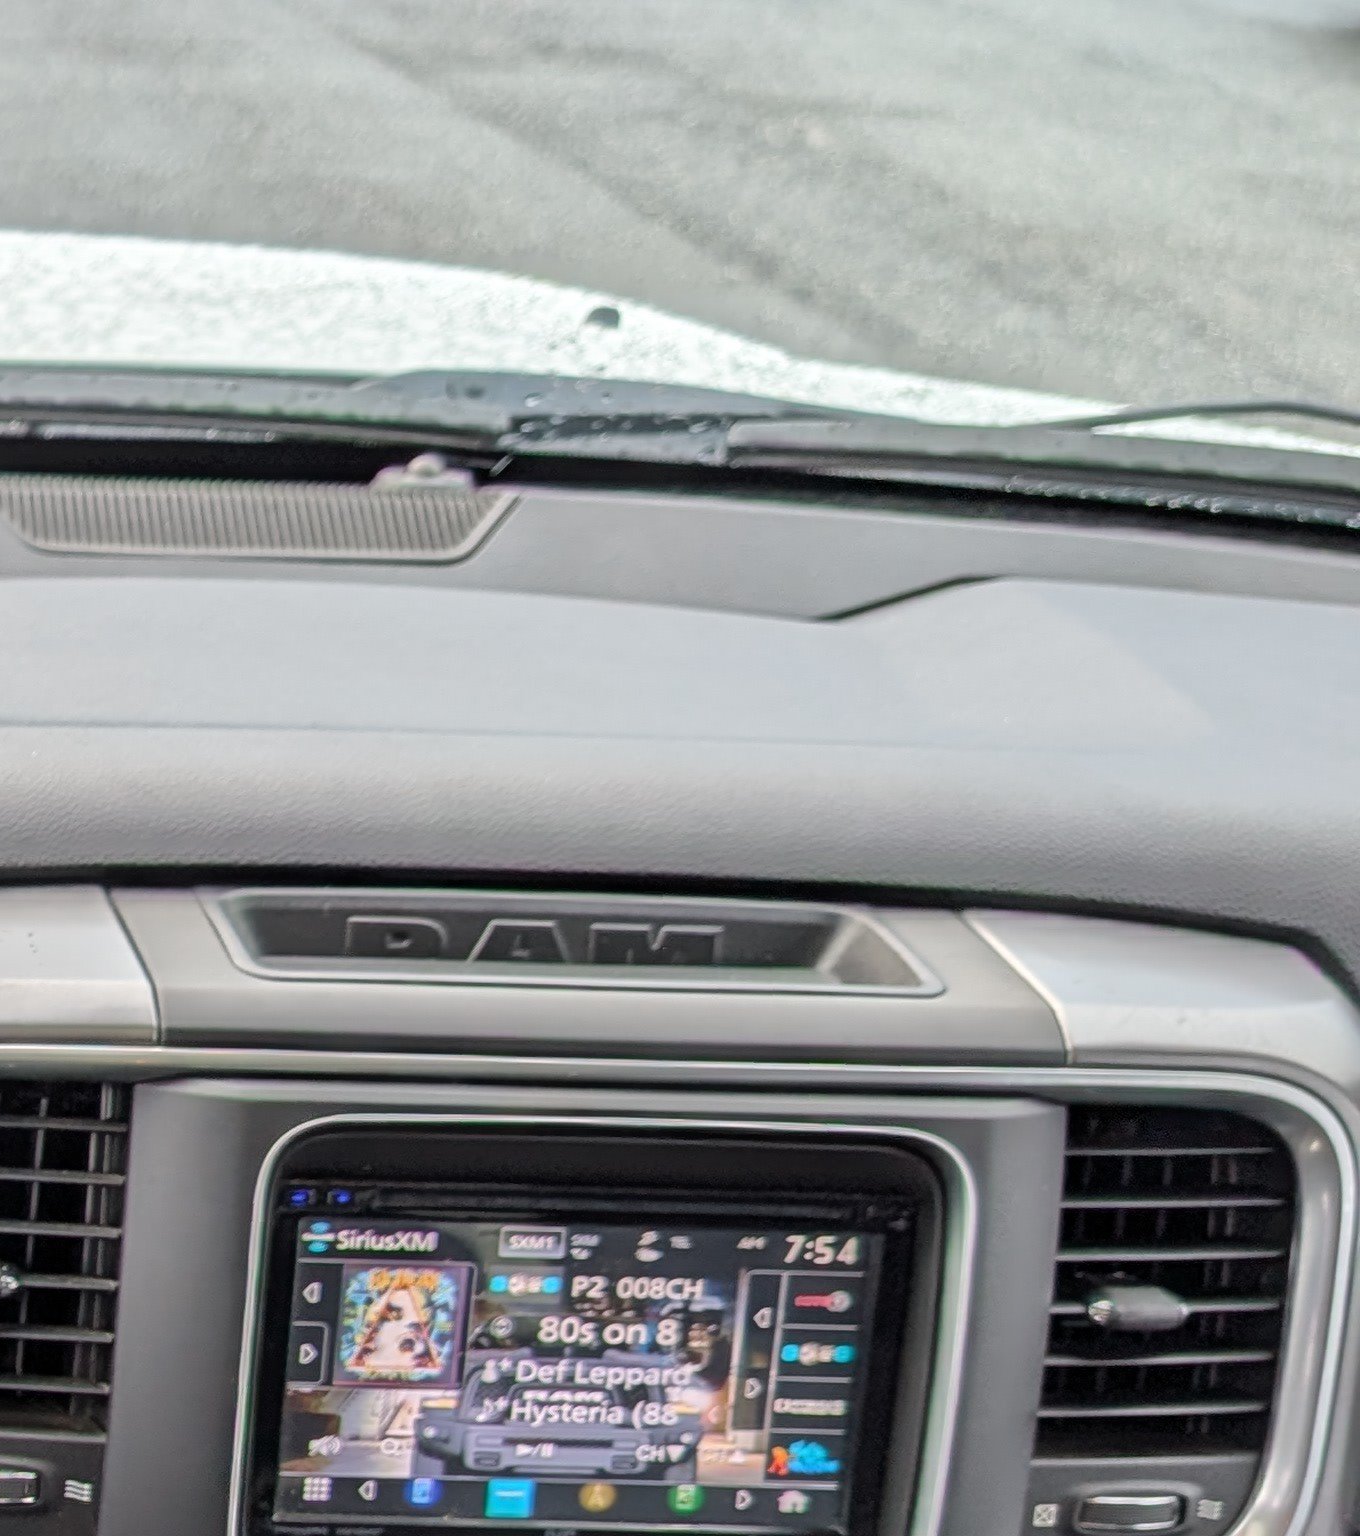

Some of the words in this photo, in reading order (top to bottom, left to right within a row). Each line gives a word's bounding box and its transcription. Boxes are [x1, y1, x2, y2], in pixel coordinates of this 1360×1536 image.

[335, 1229, 440, 1253] SiriusXM
[783, 1234, 860, 1265] 7:54
[571, 1274, 610, 1299] P2
[536, 1315, 599, 1346] 80s
[601, 1322, 649, 1346] on
[654, 1317, 683, 1347] 8
[515, 1358, 572, 1385] Def
[574, 1360, 692, 1391] Leppard
[510, 1399, 626, 1428] Hysteria
